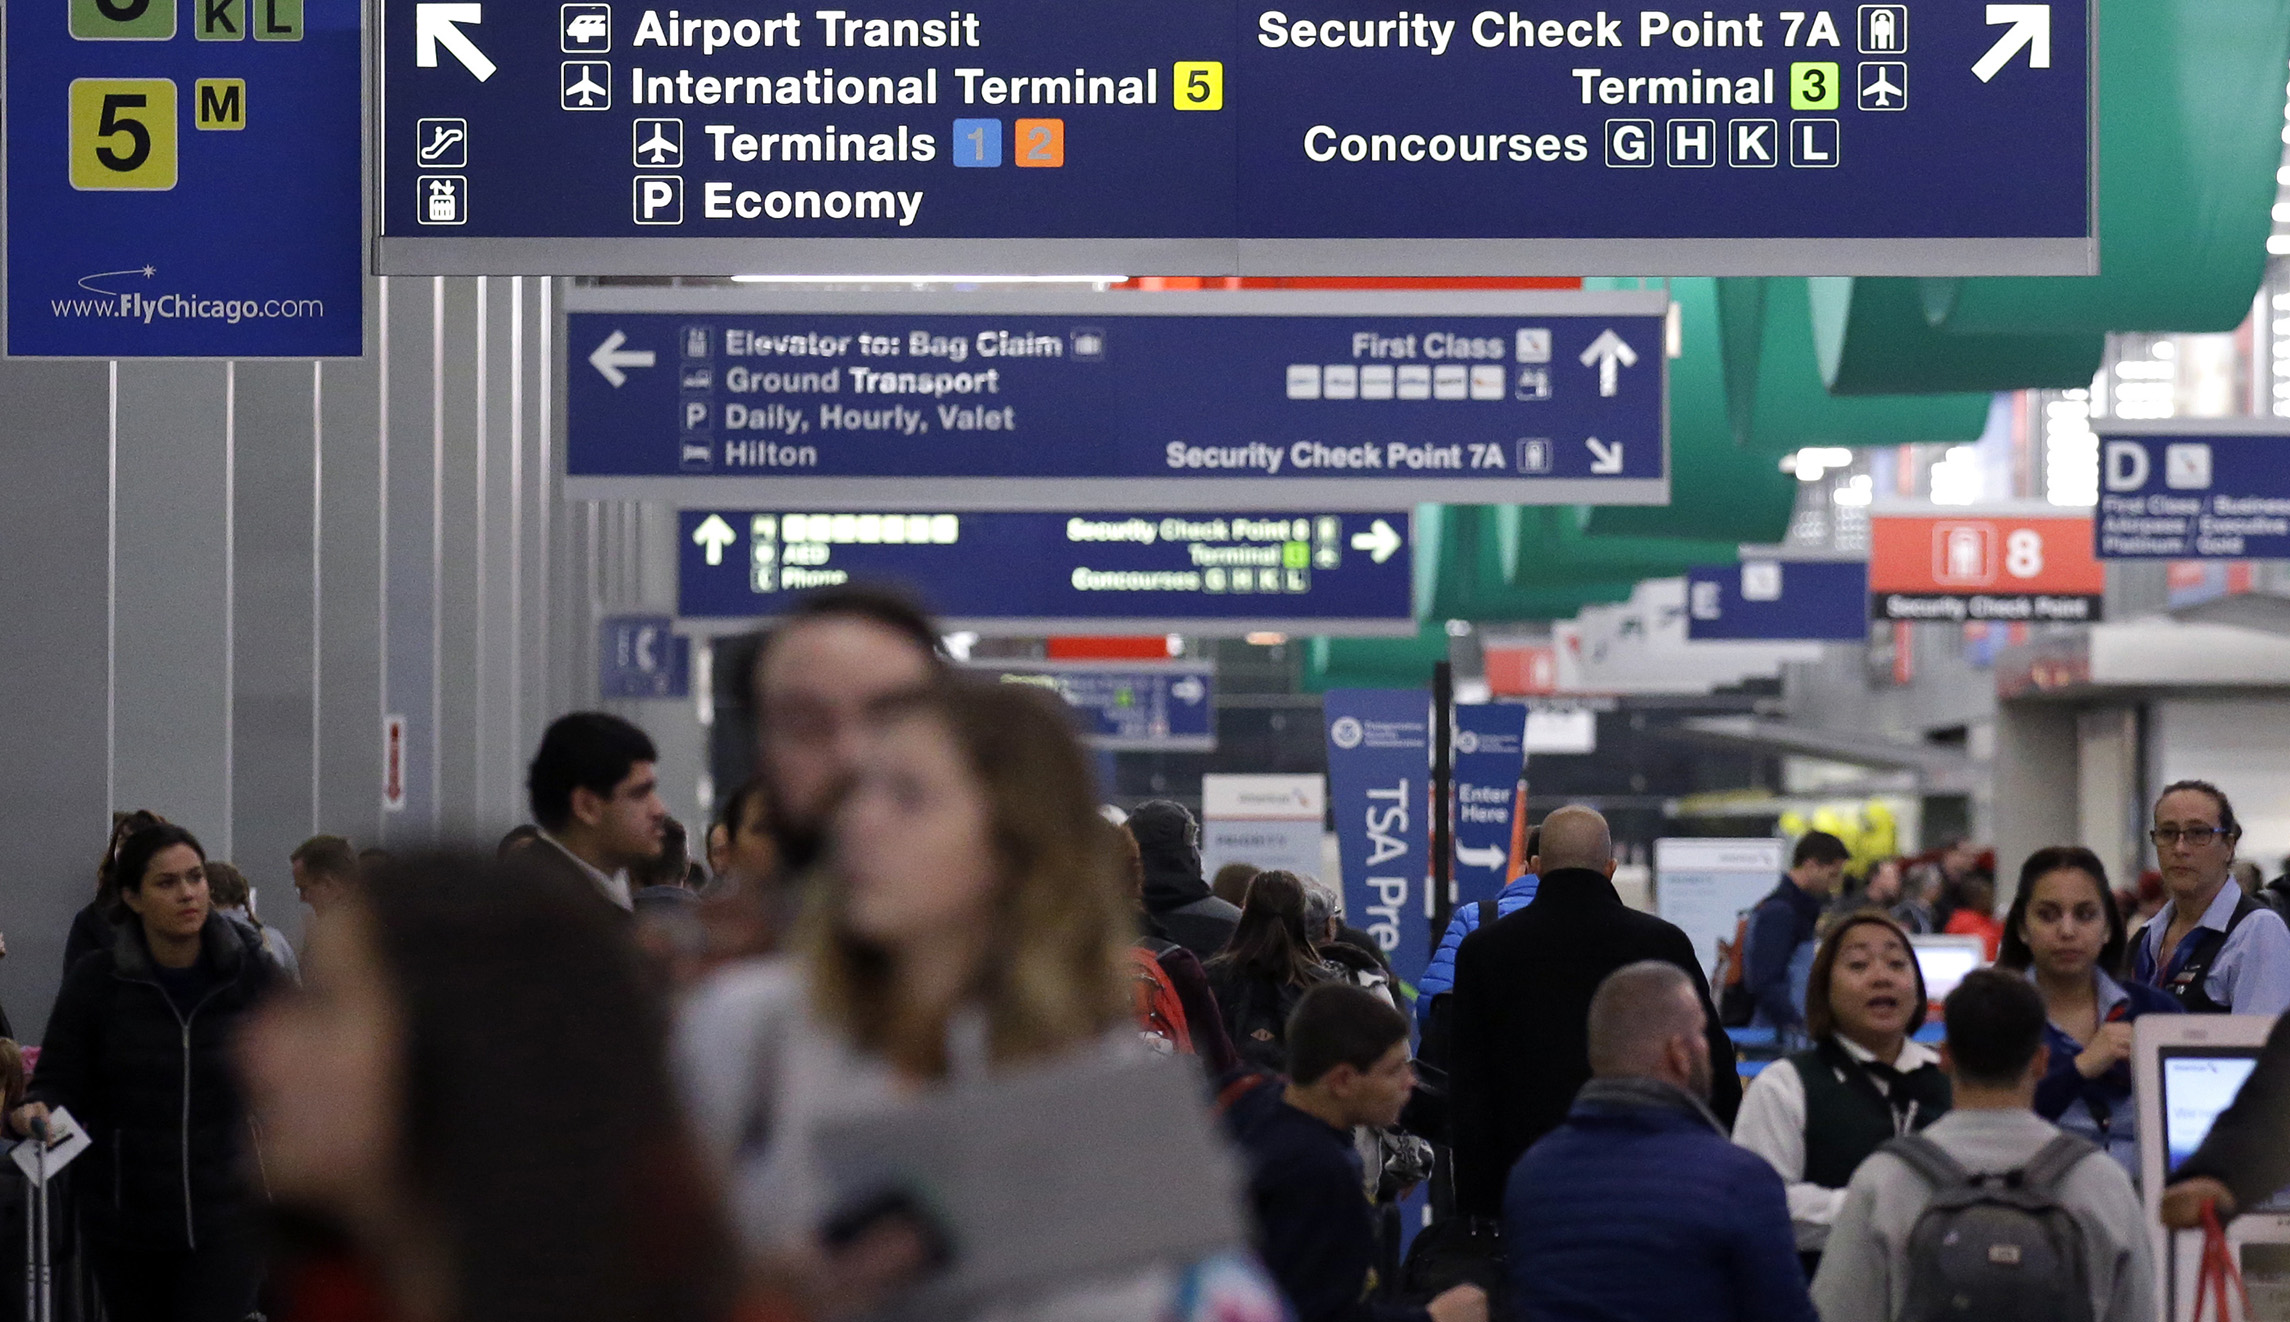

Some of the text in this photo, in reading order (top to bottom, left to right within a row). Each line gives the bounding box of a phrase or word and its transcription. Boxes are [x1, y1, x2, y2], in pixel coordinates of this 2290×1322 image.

[205, 0, 293, 34] K L
[634, 11, 980, 55] Airport Transit
[1258, 11, 1841, 56] Security Check Point 7A
[202, 86, 240, 123] M
[632, 69, 1212, 105] International Terminal 5
[1573, 69, 1828, 105] Terminal 3
[96, 94, 152, 173] 5
[705, 126, 1053, 162] Terminals 1 2
[1304, 126, 1830, 162] Concourses G H K L
[704, 183, 925, 227] Economy
[51, 293, 324, 325] www.FlyChicago.com
[725, 330, 1064, 363] Elevator to: Bag Claim
[1352, 331, 1506, 359] First Class
[726, 367, 1000, 398] Ground Transport
[725, 404, 810, 436] Daily,
[820, 404, 929, 436] Hourly,
[938, 404, 1016, 431] Valet
[725, 440, 819, 468] Hilton
[1166, 441, 1506, 475] Security Check Point 7A
[2105, 441, 2150, 492] D
[1067, 517, 1158, 544] Security
[1159, 518, 1230, 541] Check
[1232, 518, 1291, 541] Point
[2006, 529, 2044, 579] 8
[1886, 594, 2088, 620] Security Check Point
[1459, 783, 1511, 803] Enter
[1366, 778, 1409, 866] TSA
[1460, 803, 1508, 823] Here
[1366, 876, 1408, 951] Pre
